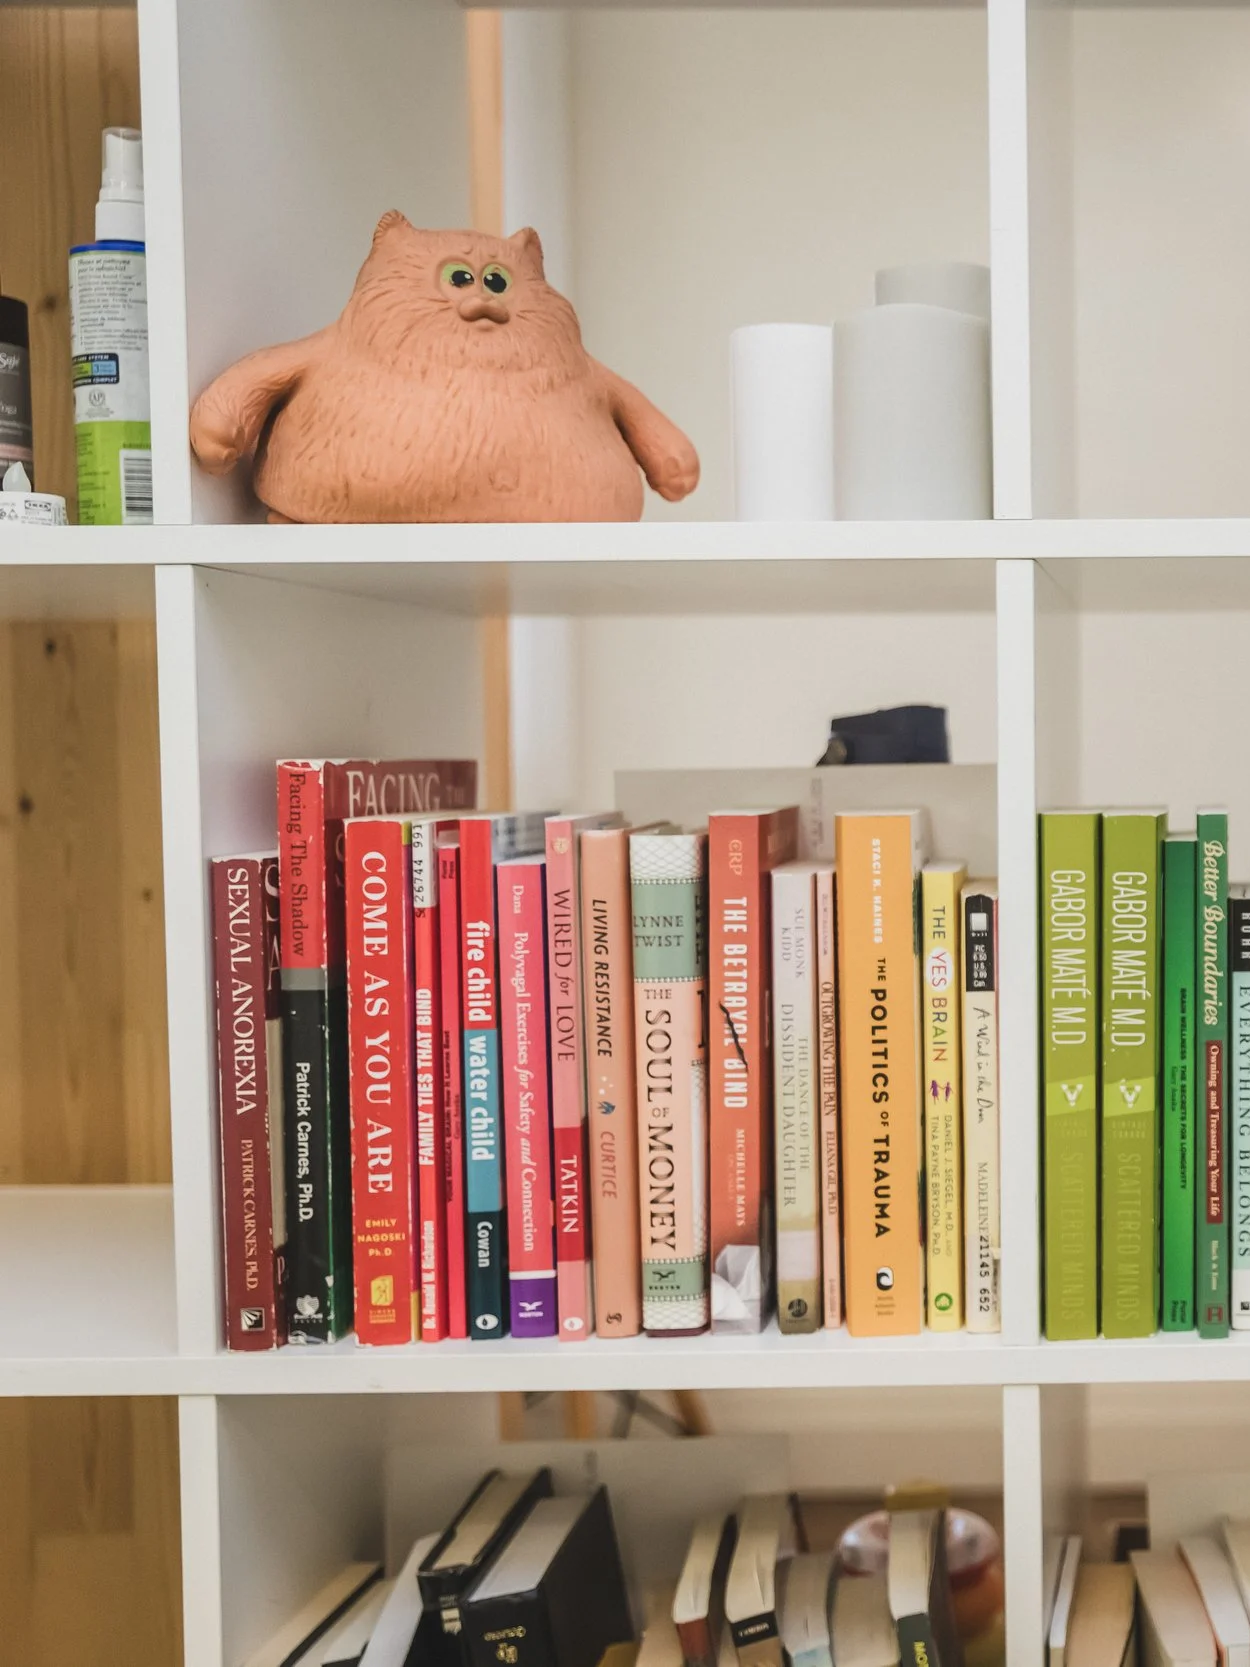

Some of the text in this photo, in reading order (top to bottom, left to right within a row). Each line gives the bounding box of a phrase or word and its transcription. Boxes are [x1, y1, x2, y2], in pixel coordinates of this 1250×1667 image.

[286, 772, 309, 957] Facing The Shadow
[412, 824, 424, 849] 991
[412, 859, 425, 904] 26744
[511, 884, 525, 914] Dana
[633, 915, 684, 928] LYNNE
[634, 935, 684, 948] TWIST
[781, 927, 792, 962] KIDD
[872, 896, 884, 944] HAINES
[1203, 840, 1227, 1026] Better Boundaries
[227, 868, 257, 1115] SEXUAL ANOREXIA
[553, 889, 576, 1062] WIRED for LOVE
[592, 899, 613, 1057] LIVING RESISTANCE
[643, 989, 672, 1000] THE
[722, 896, 748, 1108] THE BIND
[794, 937, 805, 979] MONK
[931, 905, 949, 1062] THE YES BRAIN
[1050, 869, 1092, 1052] GABOR MATÉ M.D.
[1110, 871, 1152, 1053] GABOR MATÉ M.D.
[361, 851, 393, 1194] COME AS YOU ARE
[466, 920, 496, 1161] fire child water child
[645, 1008, 673, 1103] SOUL
[973, 1006, 991, 1020] A
[976, 1026, 990, 1058] Wind
[296, 1062, 313, 1179] Patrick Carnes,
[415, 988, 435, 1166] FAMILY TIES THAT BIND
[510, 932, 538, 1252] Polyvagal Exercises for Safety and Connection
[652, 1108, 671, 1119] OF
[797, 1036, 811, 1173] THE DANCE OF THE
[823, 1091, 837, 1117] PAIN
[870, 958, 891, 1239] THE POLITICS OF TRAUMA
[239, 1140, 255, 1197] PATRICK
[600, 1131, 618, 1199] CURTICE
[782, 1106, 797, 1208] DAUGHTER
[931, 1115, 941, 1178] TINA PAYNE
[1208, 1044, 1221, 1217] Owning and Treasuring Your Life
[560, 1154, 579, 1234] TATKIN
[647, 1123, 676, 1252] MONEY
[476, 1221, 493, 1268] Cowan
[979, 1234, 991, 1313] 21145 652
